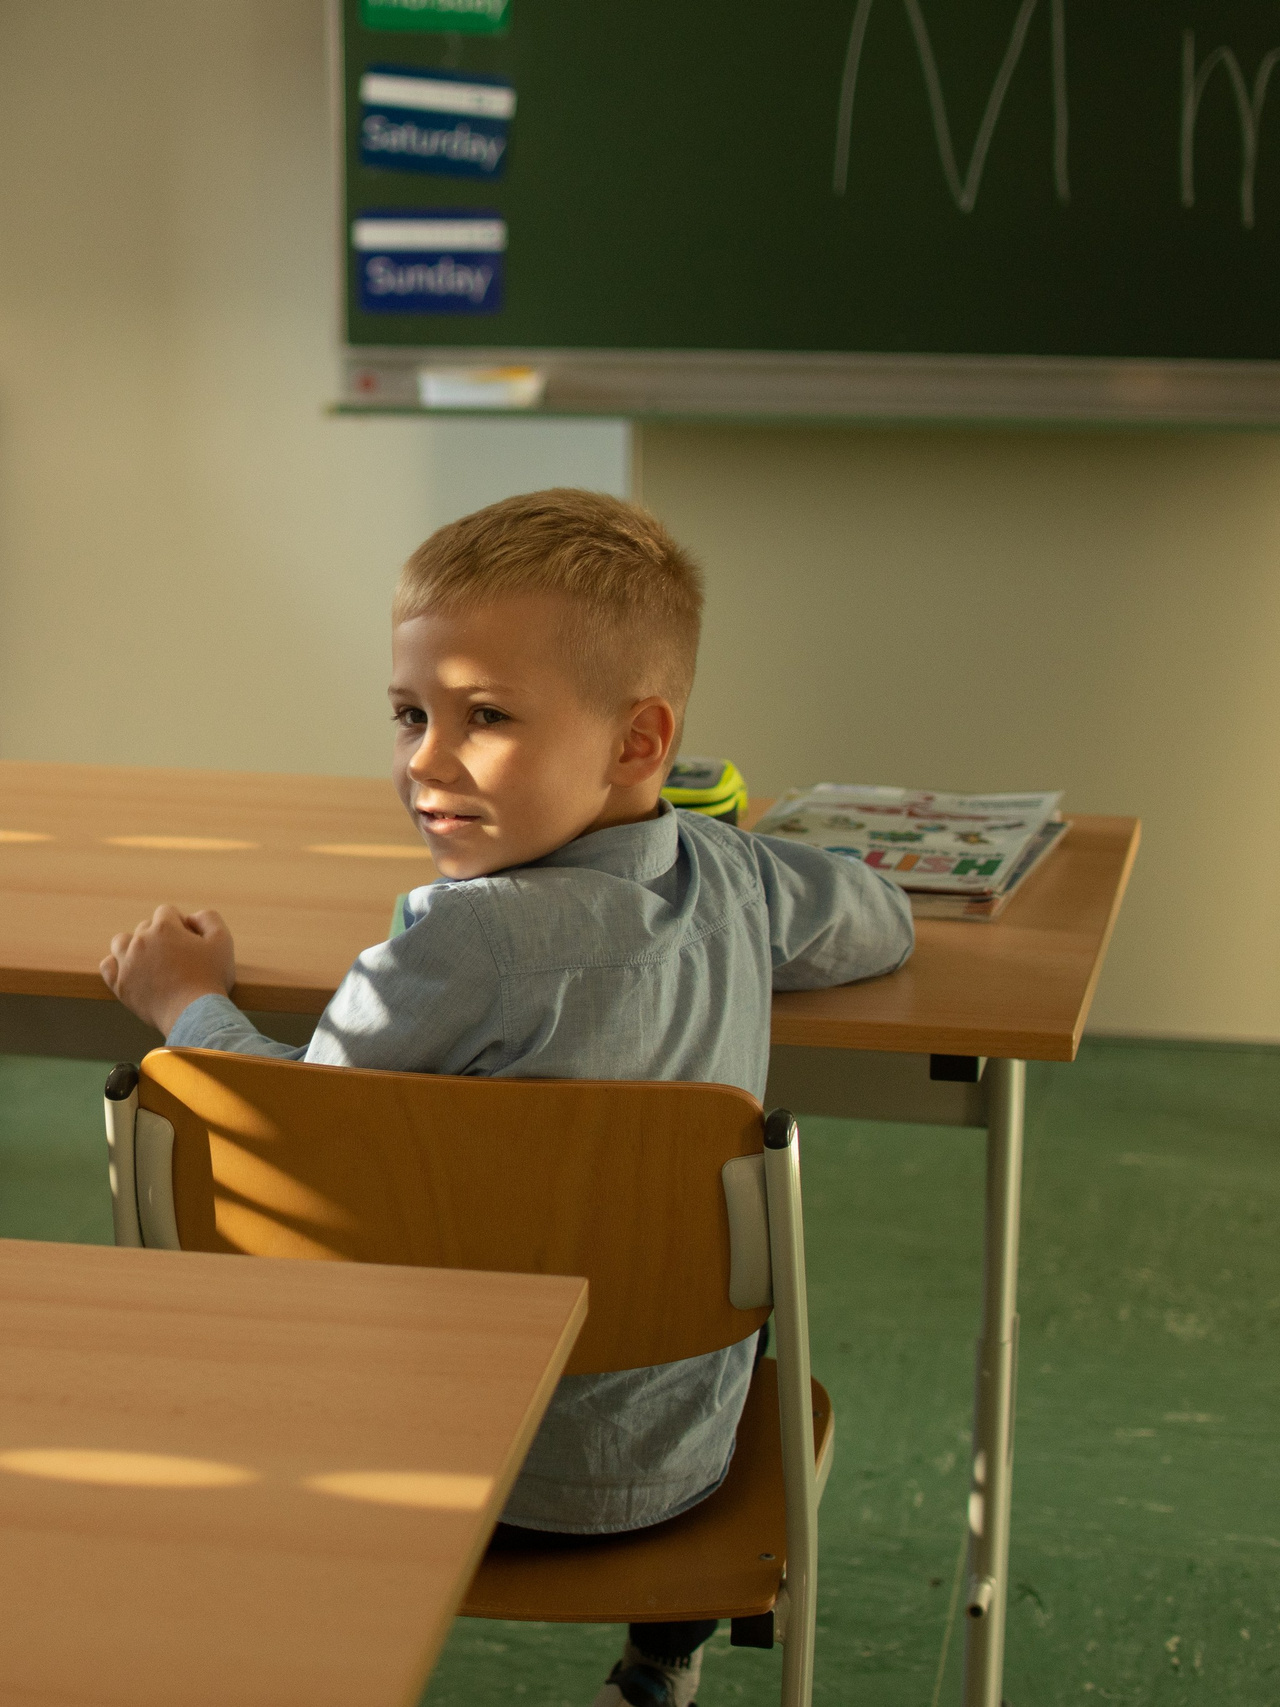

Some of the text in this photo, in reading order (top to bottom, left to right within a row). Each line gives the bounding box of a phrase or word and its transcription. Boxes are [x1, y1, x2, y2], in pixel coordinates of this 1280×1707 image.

[832, 0, 1071, 213] M
[363, 115, 506, 172] Saturday
[366, 256, 493, 303] Sunday
